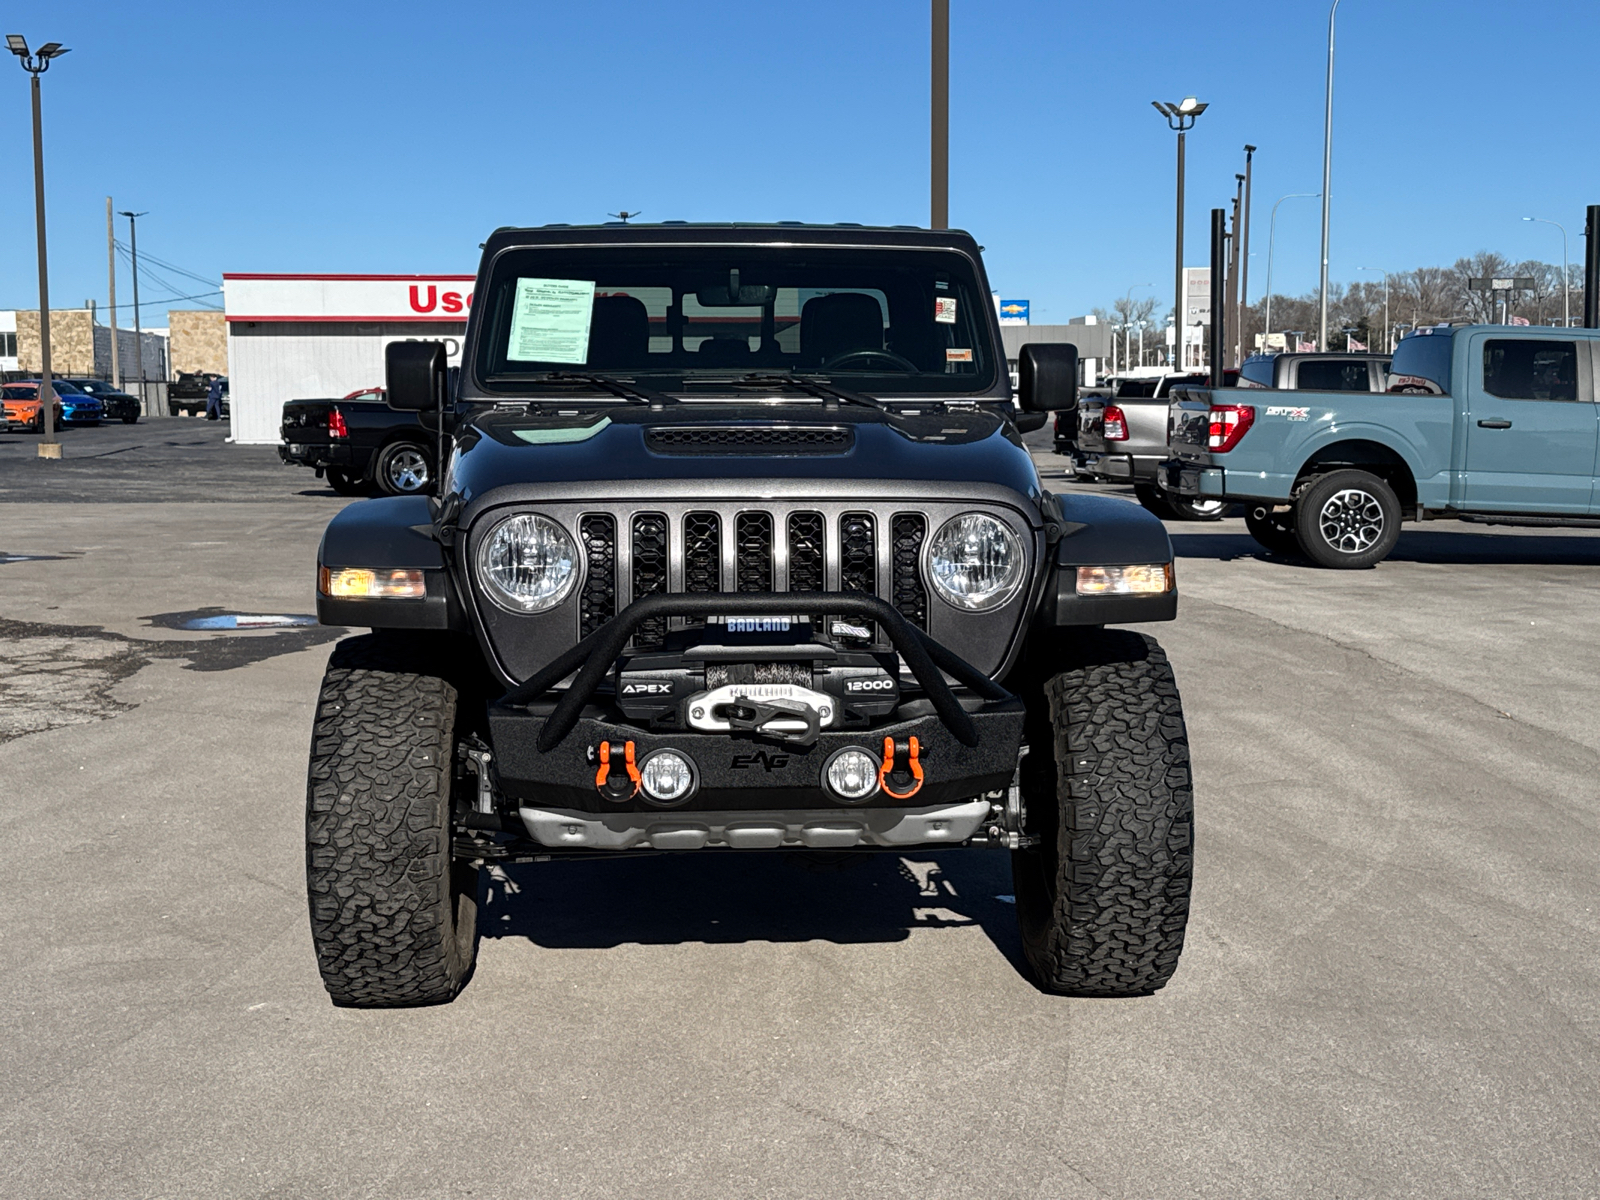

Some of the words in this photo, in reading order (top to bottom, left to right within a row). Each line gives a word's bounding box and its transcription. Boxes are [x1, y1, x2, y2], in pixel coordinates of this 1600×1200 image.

[727, 617, 791, 632] BADLAND
[622, 684, 673, 694] APEX
[846, 680, 893, 691] 12000
